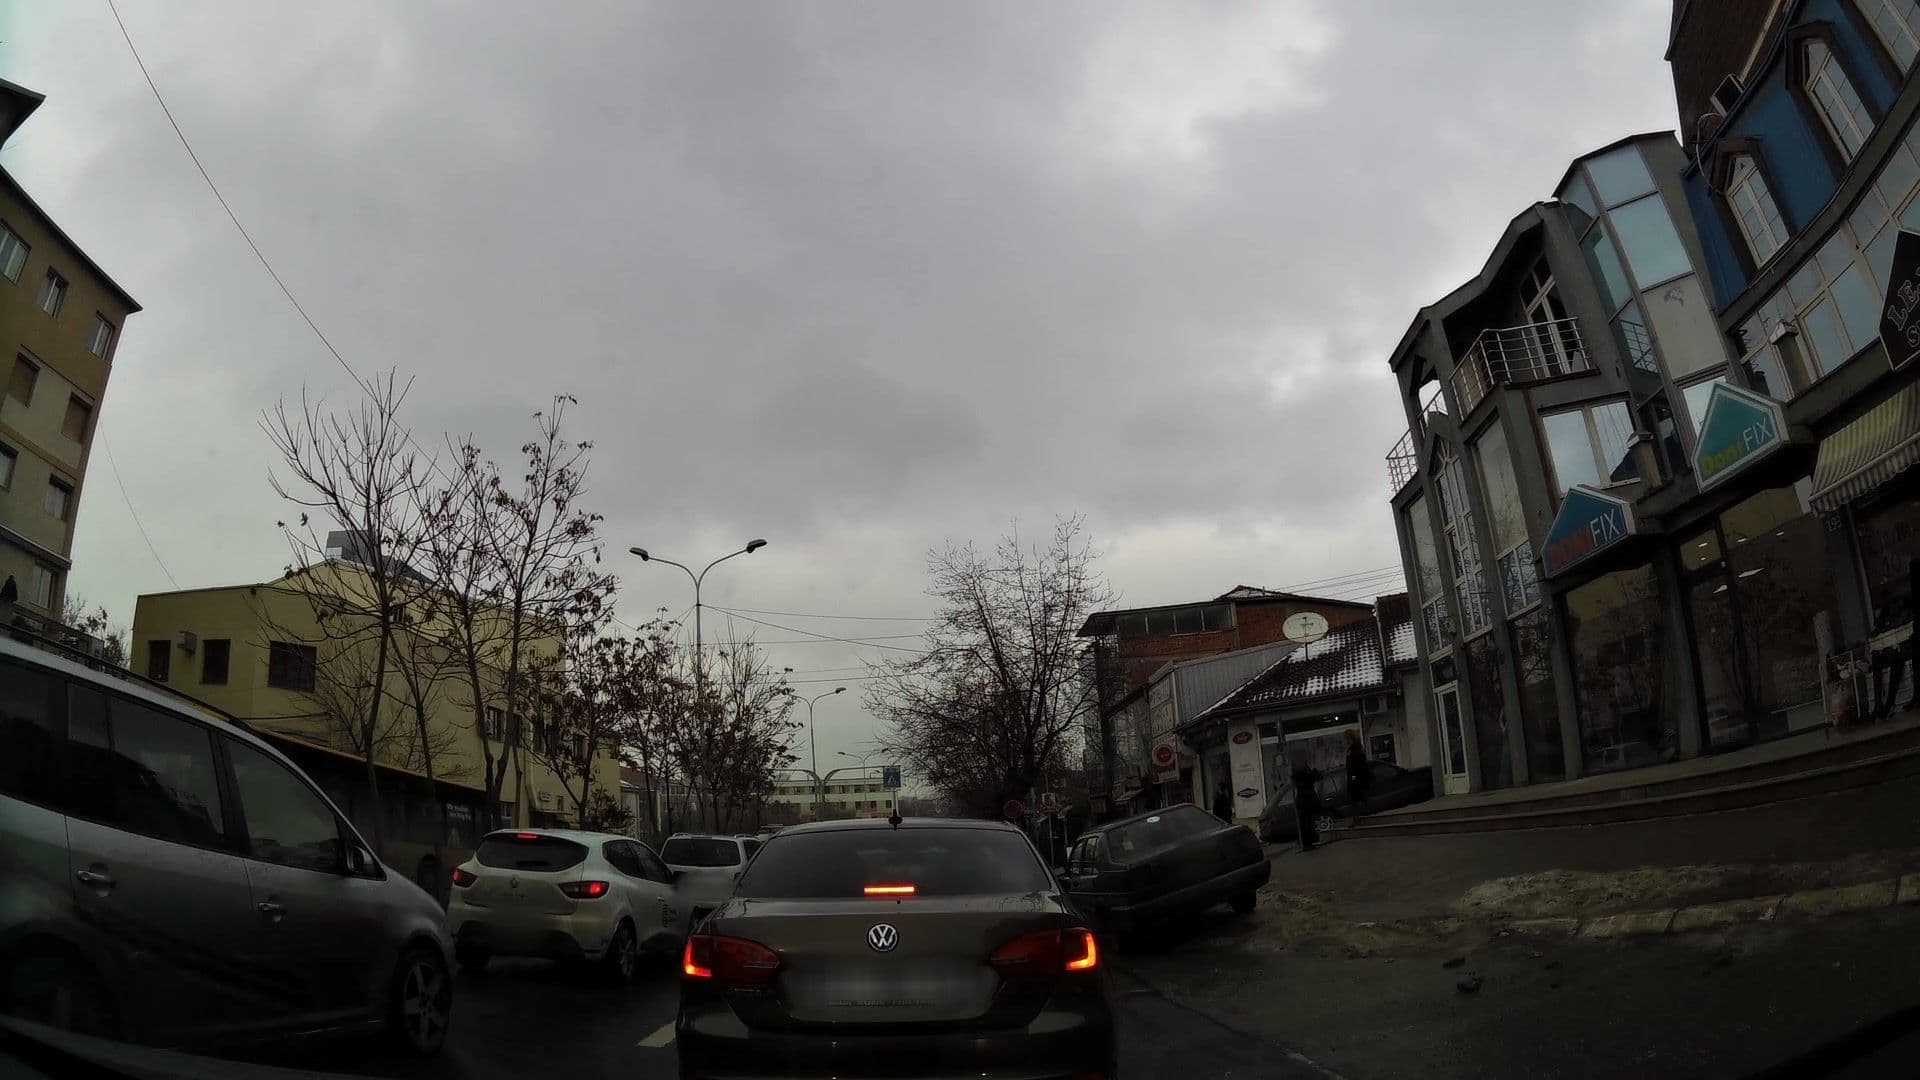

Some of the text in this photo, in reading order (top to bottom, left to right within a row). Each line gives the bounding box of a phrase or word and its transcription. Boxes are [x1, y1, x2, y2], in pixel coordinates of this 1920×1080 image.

[1742, 416, 1773, 453] FIX
[1589, 508, 1621, 548] FIX
[868, 923, 898, 952] VW
